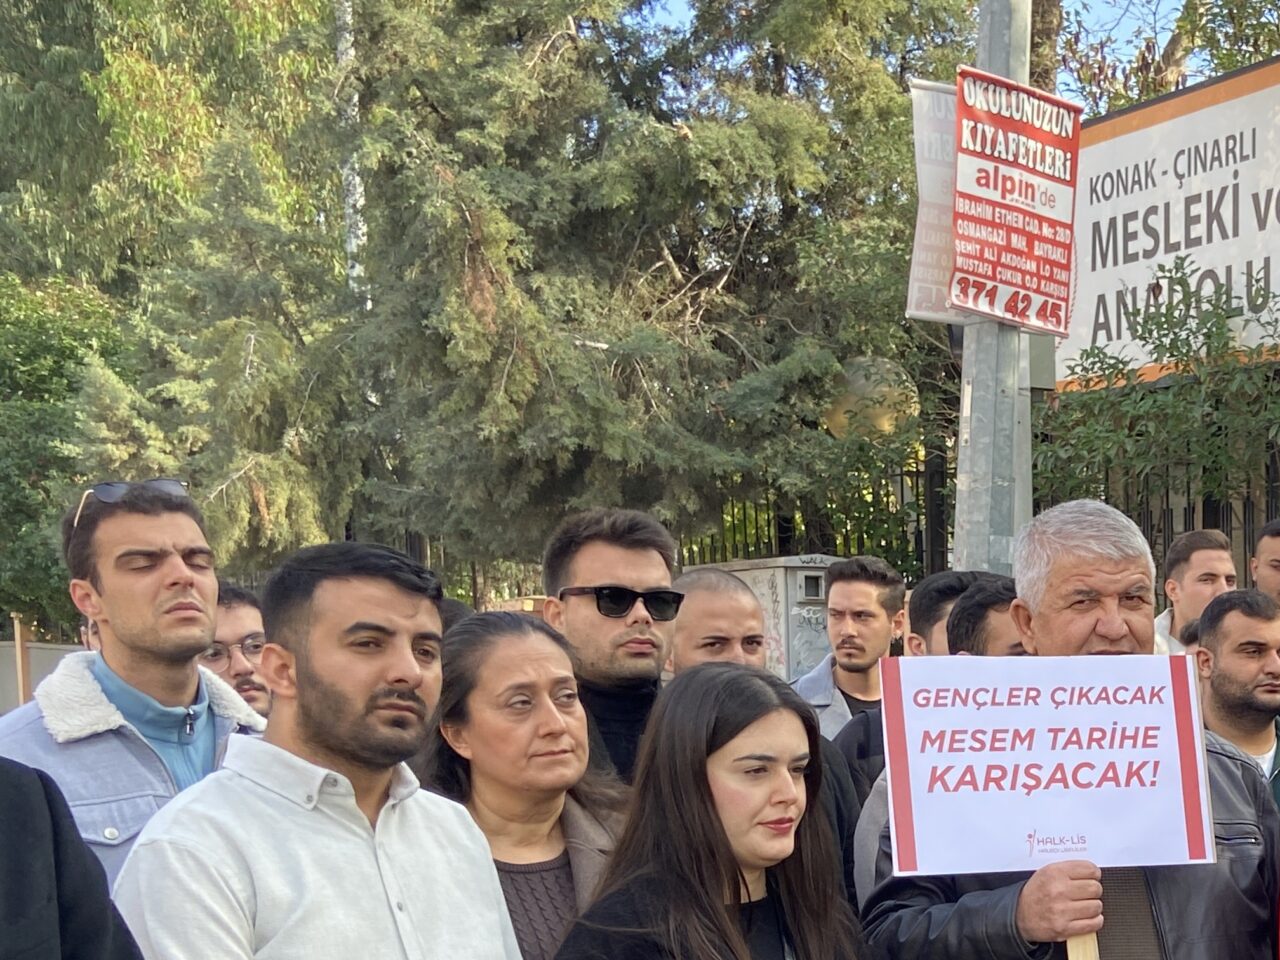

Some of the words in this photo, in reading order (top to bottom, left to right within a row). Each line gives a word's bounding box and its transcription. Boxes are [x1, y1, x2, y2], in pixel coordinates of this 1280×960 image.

[963, 76, 1074, 139] OKULUNUZUN
[1089, 158, 1157, 205] KONAK
[1173, 127, 1257, 187] ÇINARLI
[955, 192, 993, 221] İBRAHİM
[994, 207, 1024, 230] ETHEM
[1091, 169, 1240, 272] MESLEKİ
[957, 218, 1006, 246] OSMANGAZİ
[1034, 240, 1068, 265] BAYRAKLI
[956, 255, 993, 278] MUSTAFA
[996, 266, 1022, 286] ÇUKUR
[956, 276, 998, 312] 371
[1004, 290, 1032, 322] 42
[1036, 299, 1062, 329] 45
[913, 687, 1041, 711] GENÇLER
[1050, 685, 1166, 710] ÇIKACAK
[920, 728, 1036, 753] MESEM
[1047, 721, 1160, 750] TARİHE
[927, 761, 1160, 796] KARIŞACAK!
